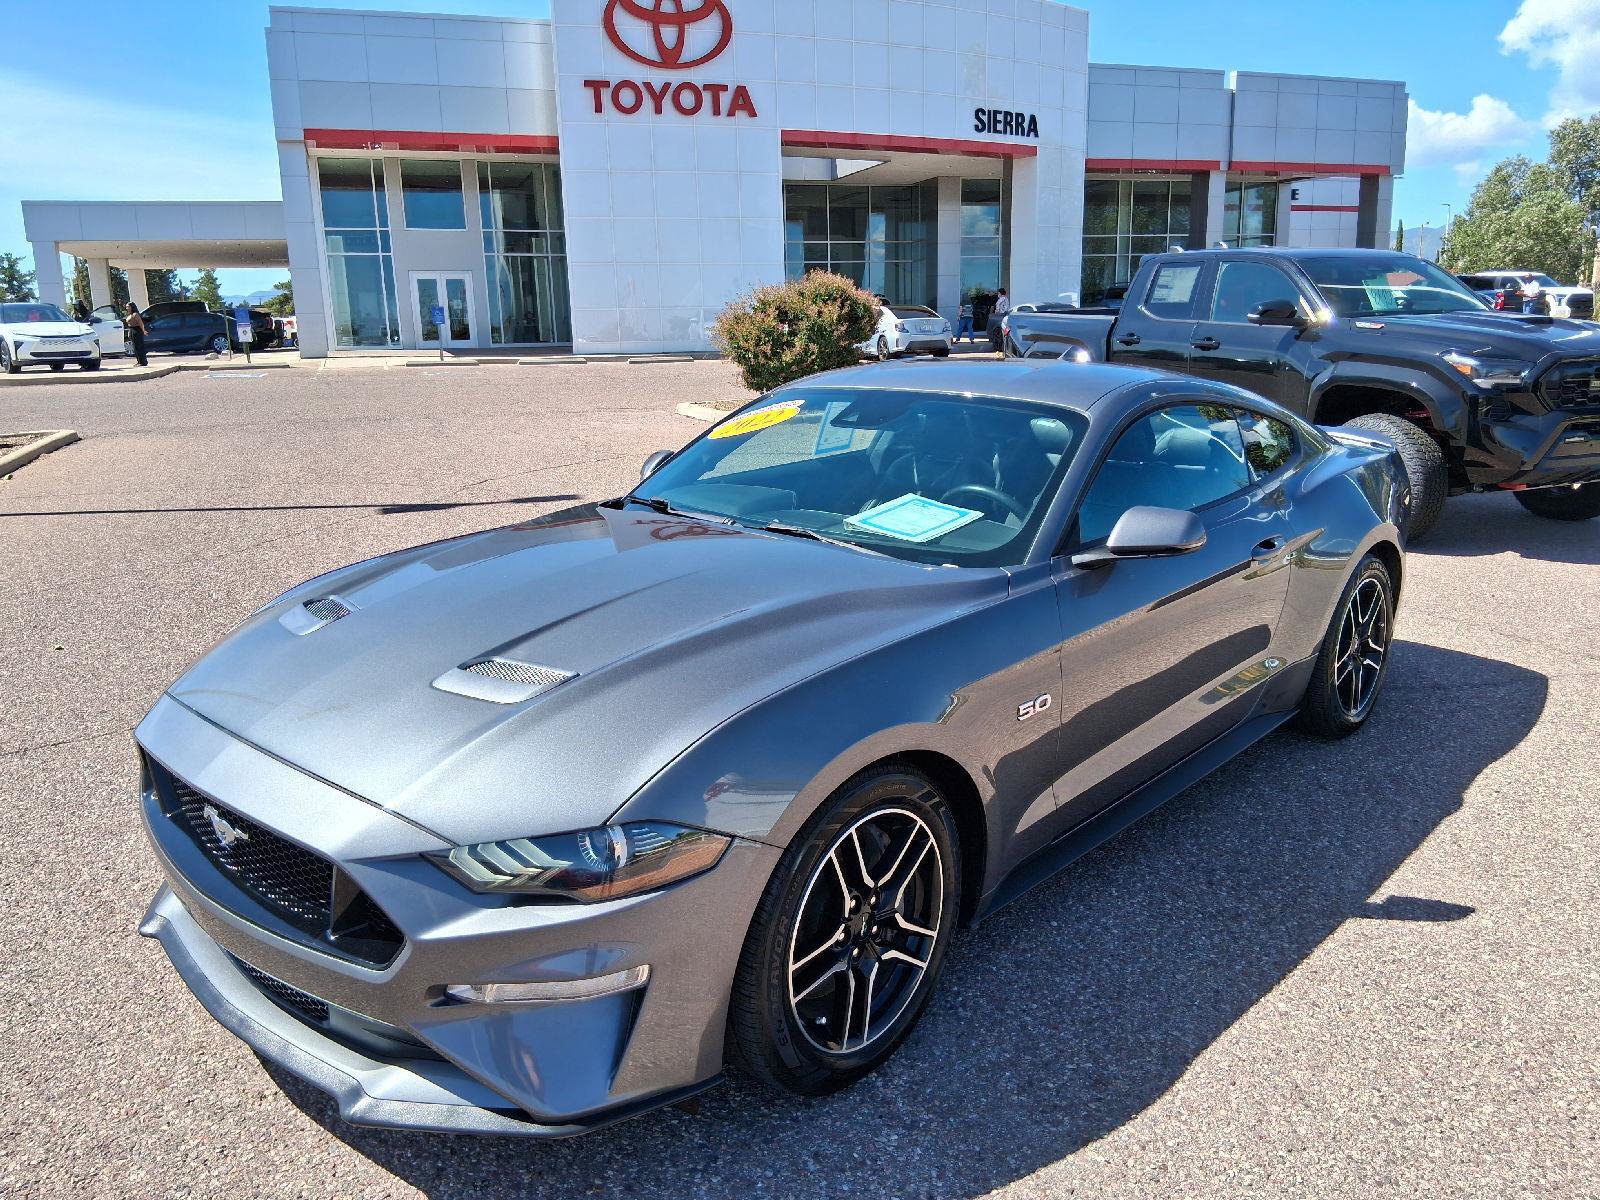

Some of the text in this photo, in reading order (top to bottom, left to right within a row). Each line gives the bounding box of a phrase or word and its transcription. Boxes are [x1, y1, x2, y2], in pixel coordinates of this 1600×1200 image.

[583, 80, 758, 117] TOYOTA
[974, 107, 1039, 138] SIERRA
[1017, 692, 1051, 720] 5.0
